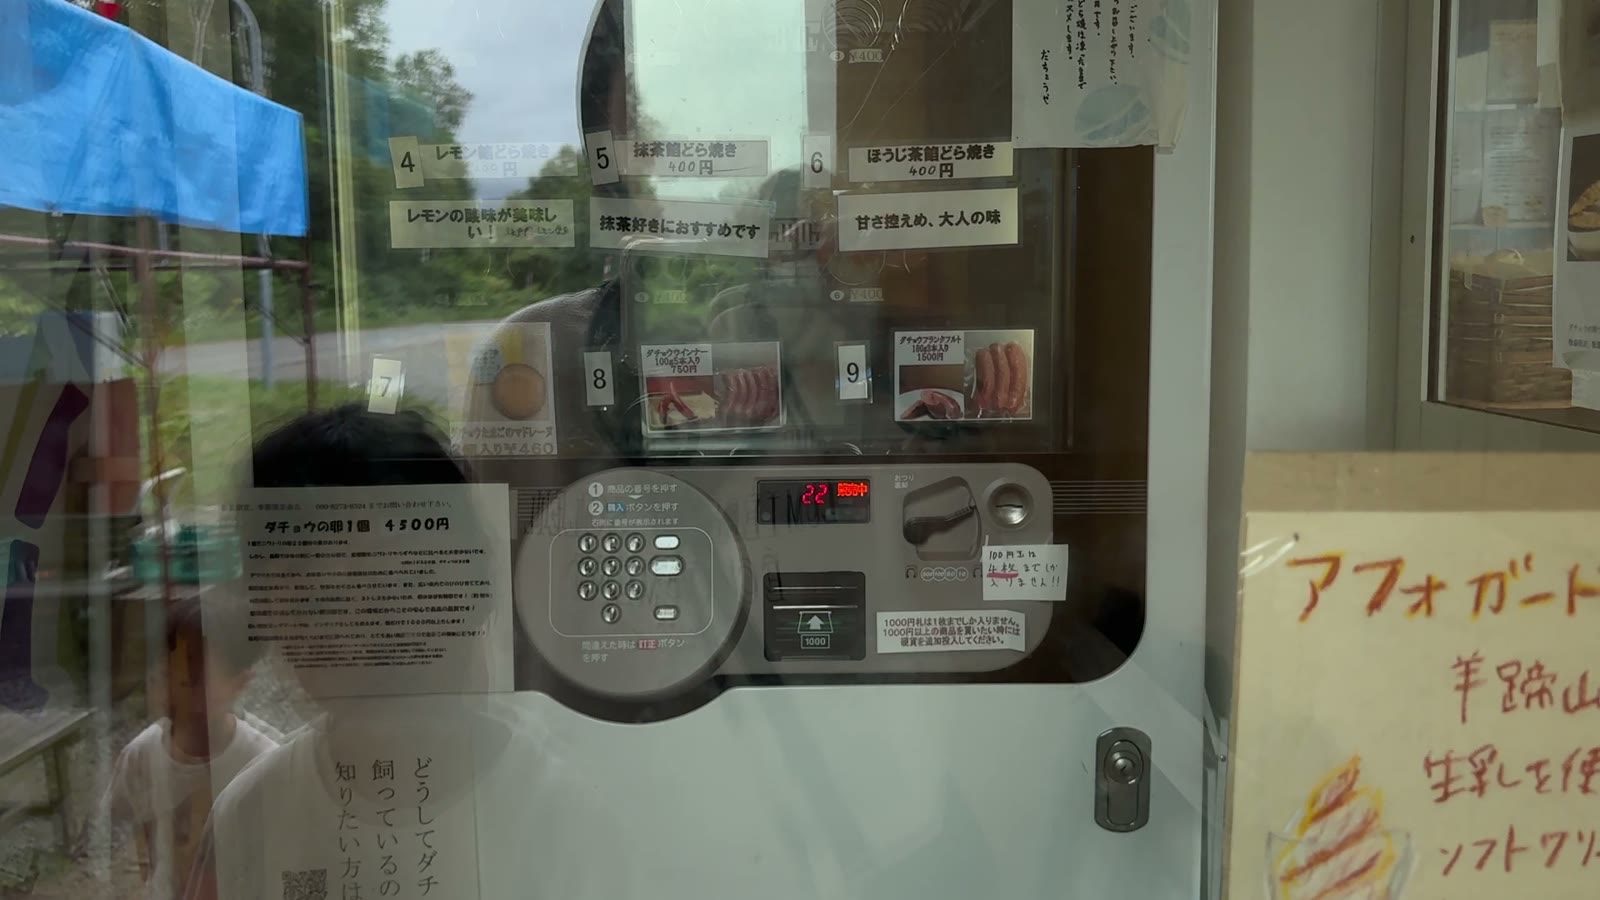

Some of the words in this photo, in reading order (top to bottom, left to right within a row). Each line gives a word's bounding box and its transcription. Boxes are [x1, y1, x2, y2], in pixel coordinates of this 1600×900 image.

[596, 146, 610, 170] 5
[633, 141, 738, 158] 抹茶餡どら焼き
[866, 144, 995, 164] ほうじ茶餡どら焼き
[400, 151, 416, 174] 4
[667, 159, 714, 175] 400円
[809, 151, 824, 174] 6
[908, 162, 955, 179] 400円
[407, 207, 557, 224] レモンの酸味が美味し
[855, 209, 1001, 231] 甘さ控えめ、大人の味
[599, 214, 761, 240] 抹茶好きにおすすめです
[592, 367, 607, 390] 8
[846, 363, 860, 384] 9
[379, 375, 393, 399] 7
[801, 484, 828, 504] 22
[384, 516, 450, 534] 4500円
[883, 616, 1020, 629] 1000円札は1枚までしか入りません。
[883, 625, 1021, 638] 1000円以上の商品を買いたい時には
[803, 636, 827, 647] 1000
[371, 759, 401, 897] 飼っているの
[413, 756, 440, 897] どうしてダチ
